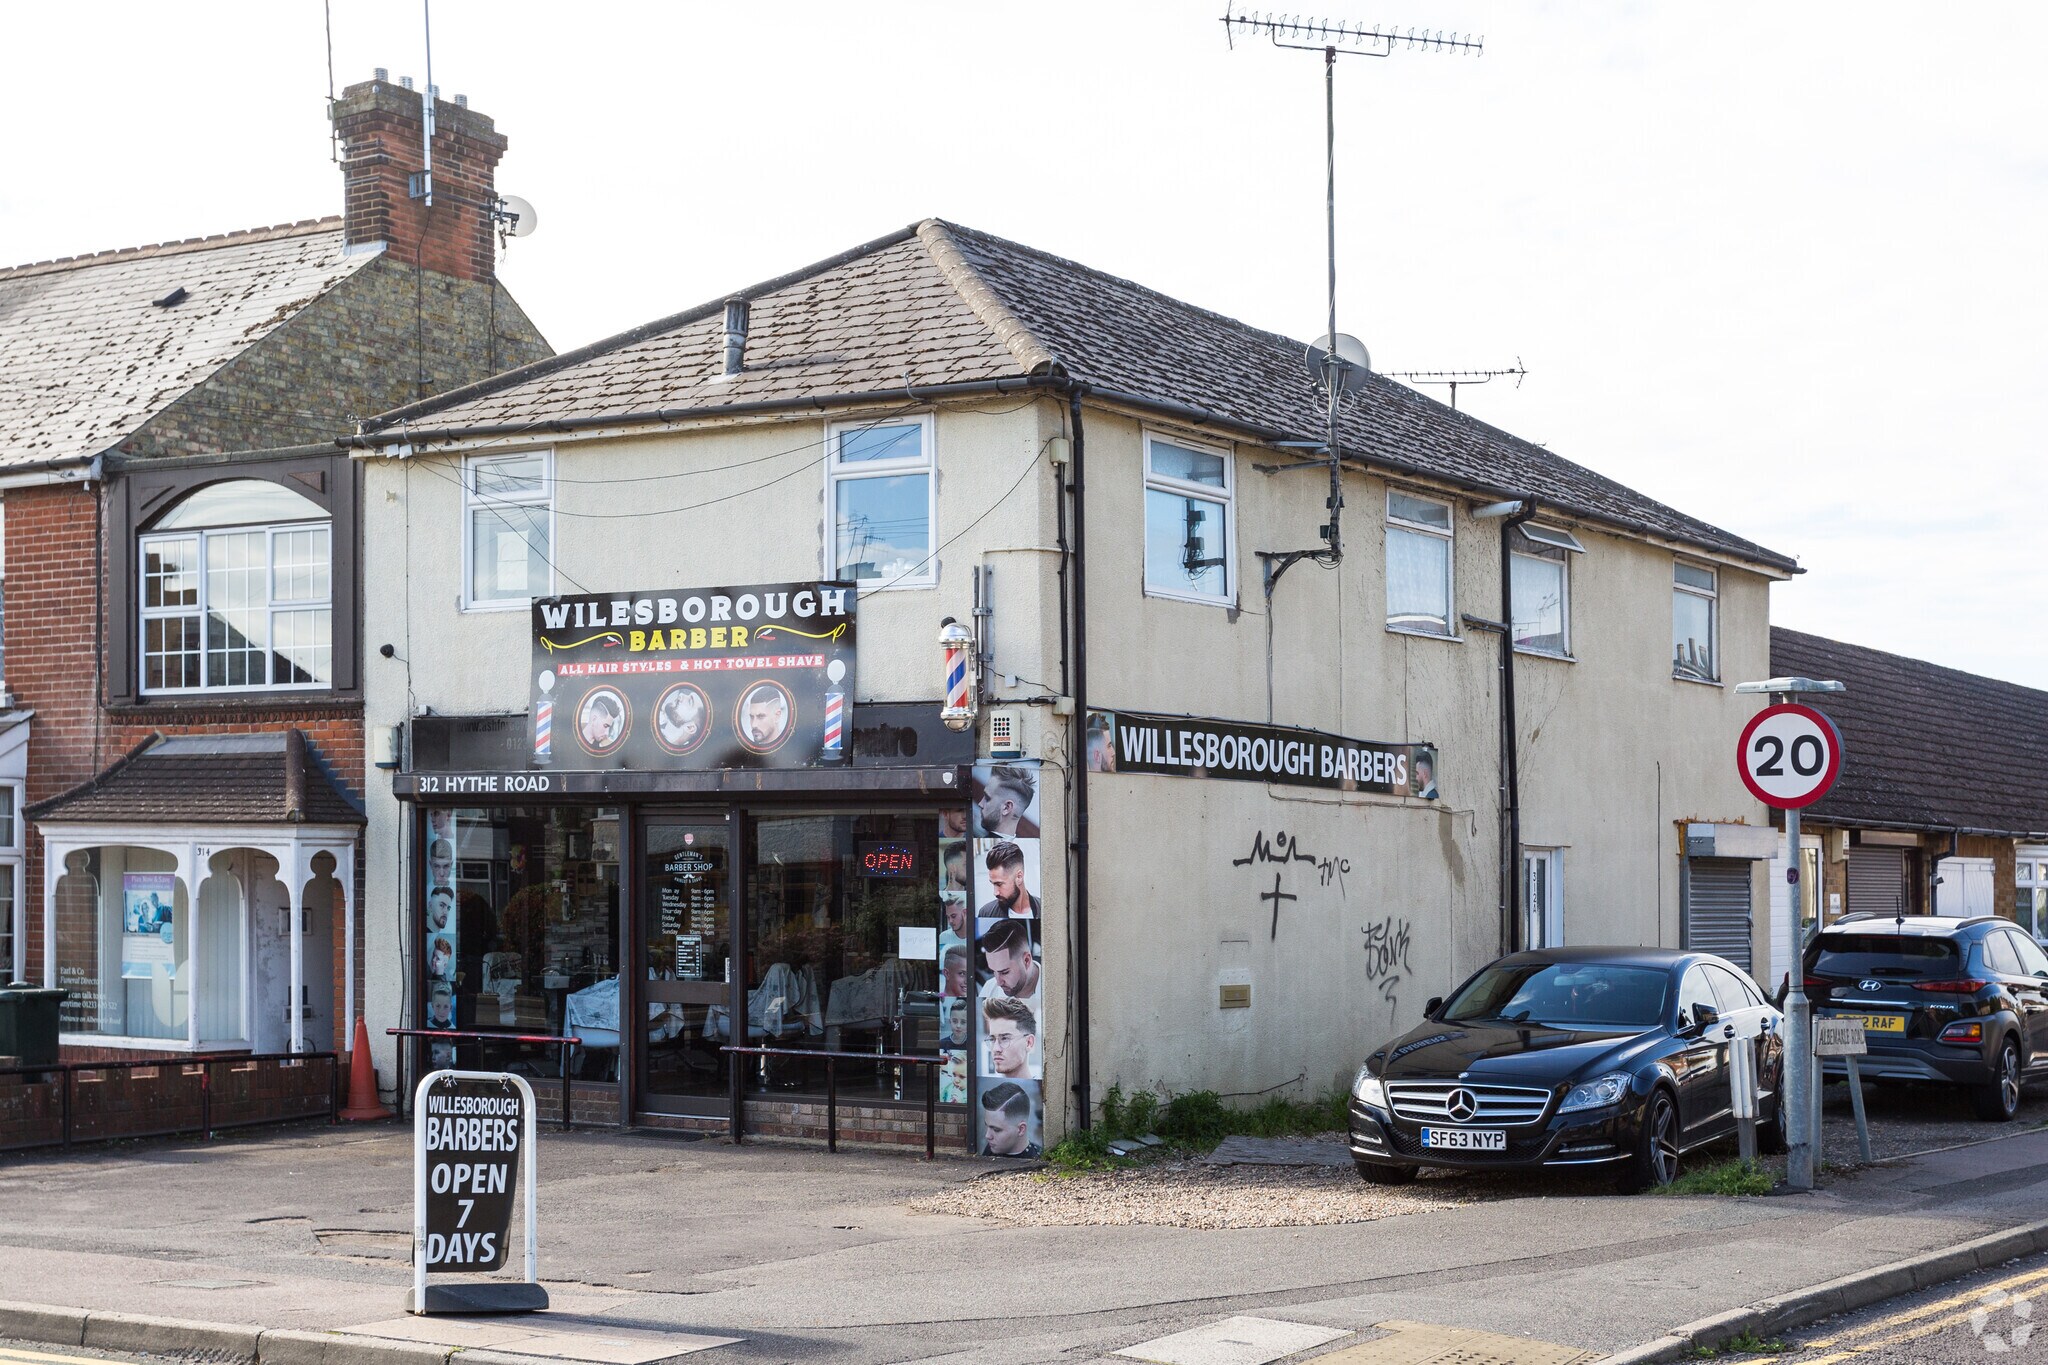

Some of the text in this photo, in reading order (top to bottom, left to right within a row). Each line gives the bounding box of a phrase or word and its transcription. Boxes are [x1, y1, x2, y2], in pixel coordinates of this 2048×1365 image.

[540, 590, 846, 629] WILESBOROUGH
[630, 626, 748, 652] BARBER
[560, 655, 823, 675] ALL HAIR STYLES & HOT TOWEL SHAVE
[1120, 726, 1407, 785] WILLESBOROUGH BARBERS
[1754, 735, 1824, 776] 20
[420, 776, 550, 792] 312 HYTHE ROAD
[197, 848, 210, 856] 314
[865, 853, 913, 869] OPEN
[1872, 1017, 1896, 1028] RAF
[1819, 1028, 1864, 1045] ALBEMARLE ROAD
[428, 1096, 519, 1116] WILLESBOROUGH
[426, 1117, 518, 1152] BARBERS
[1431, 1131, 1503, 1147] SF63 NYP
[431, 1163, 508, 1194] OPEN
[457, 1199, 474, 1228] 7
[426, 1232, 496, 1264] DAYS
